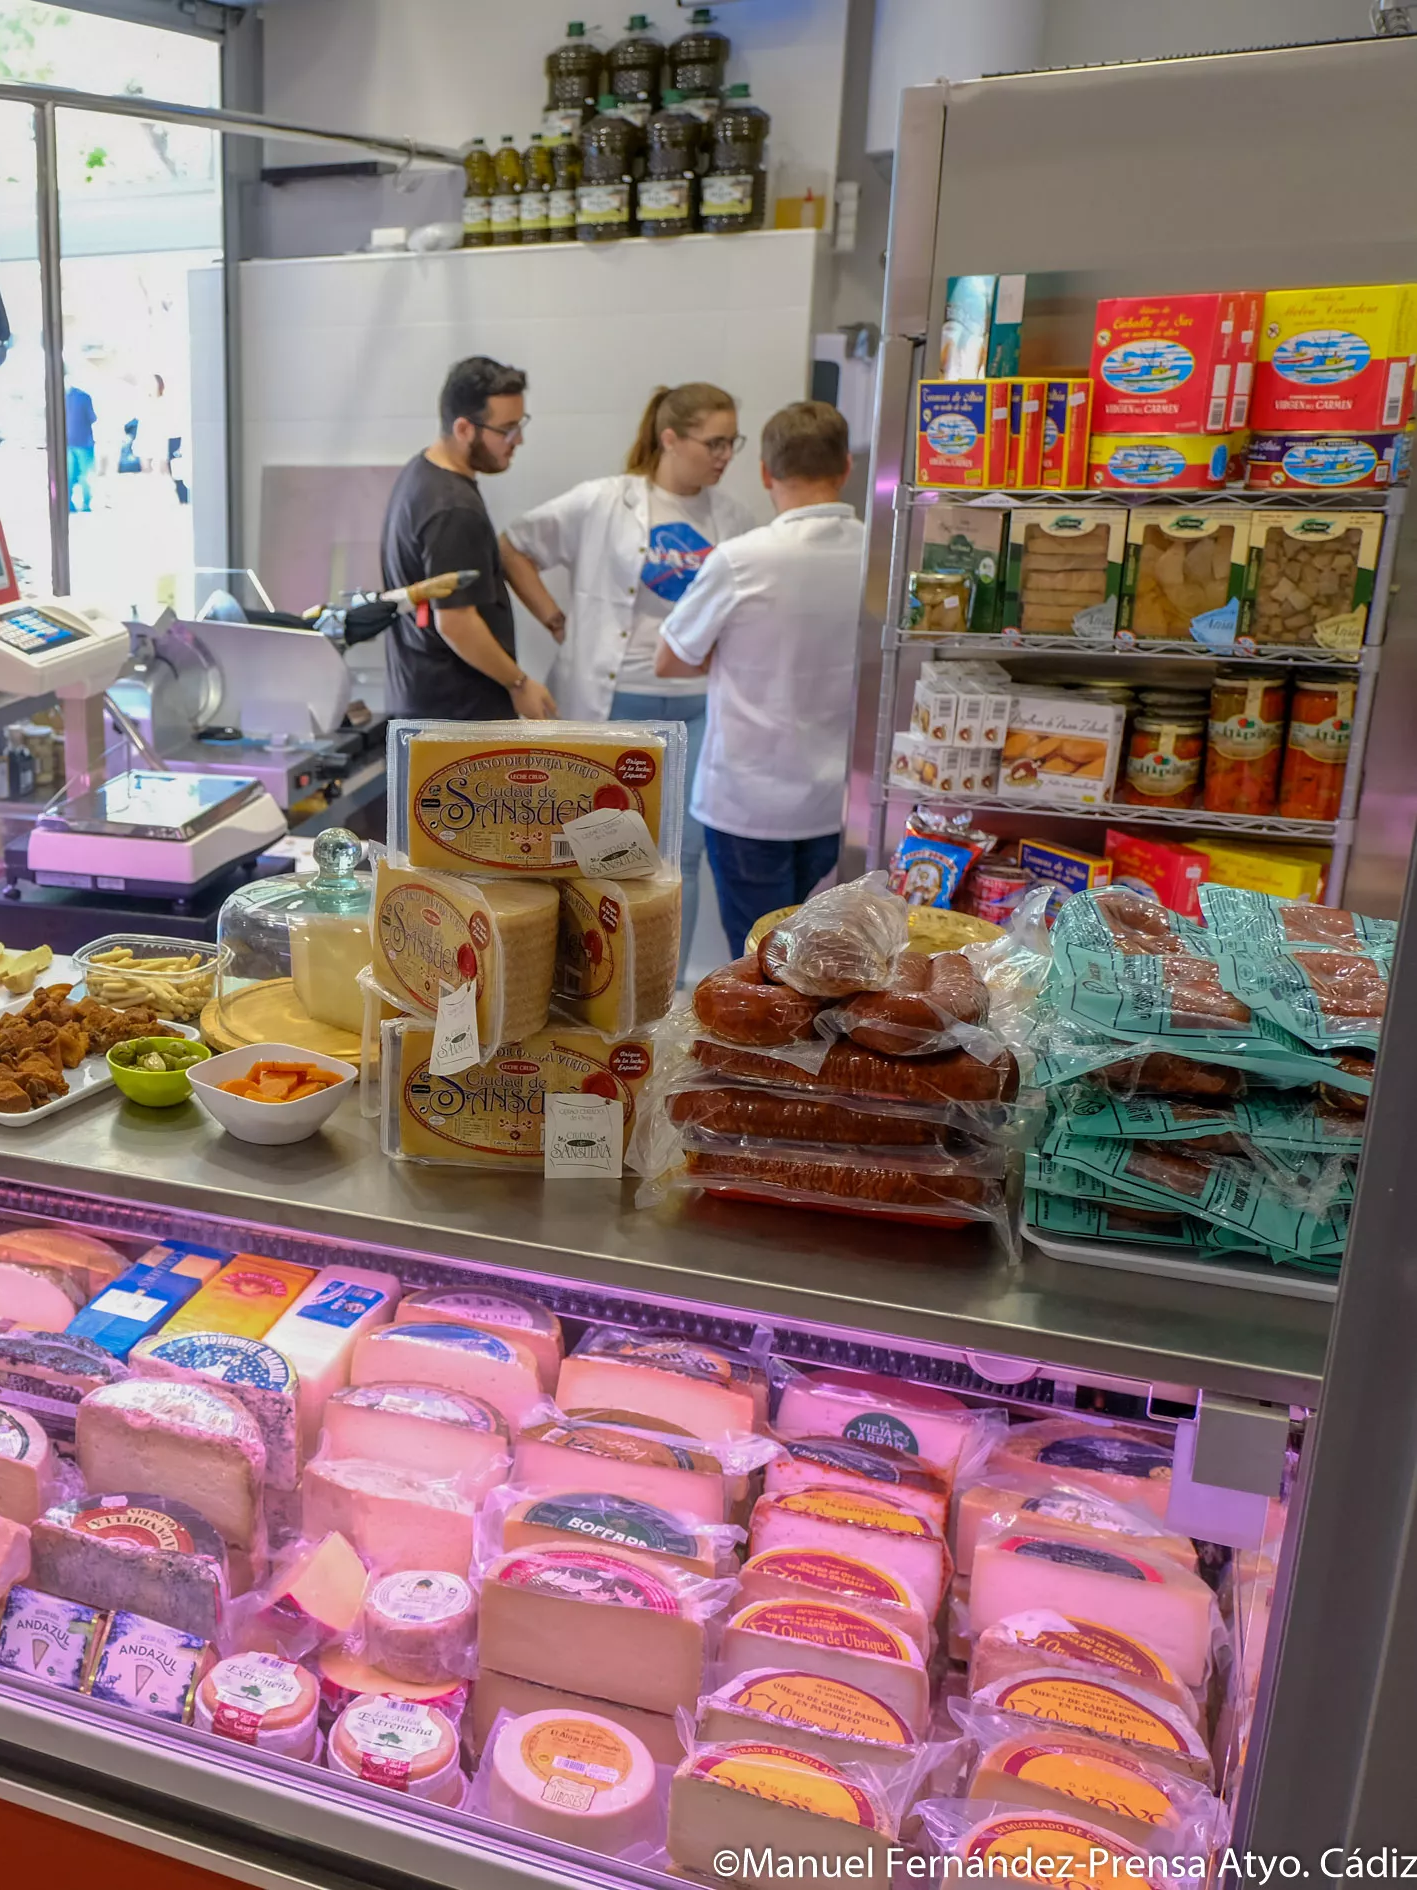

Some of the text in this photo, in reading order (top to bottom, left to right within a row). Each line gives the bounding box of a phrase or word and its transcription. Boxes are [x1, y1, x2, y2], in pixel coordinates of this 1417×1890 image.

[647, 546, 703, 570] NAS
[457, 756, 600, 780] QUESO DE OVEJA VIEJO
[509, 773, 548, 781] LECHE CRUDA
[475, 781, 558, 798] Ciudad de
[440, 778, 593, 831] SANSUEÑ
[466, 1070, 547, 1088] Ciudad de
[500, 1064, 518, 1072] LECHE
[566, 1131, 597, 1139] CIUDAD
[859, 1422, 892, 1439] VIEJA
[880, 1420, 890, 1428] LA
[17, 1619, 71, 1649] ANDAZUL
[781, 1626, 891, 1653] Quesos de Ubrique
[119, 1644, 177, 1675] ANDAZUL
[226, 1664, 295, 1693] Extremeña
[815, 1683, 861, 1701] MADURADO
[1030, 1688, 1066, 1702] QUESO
[1067, 1697, 1081, 1706] DE
[1083, 1702, 1117, 1717] CABRA
[773, 1682, 891, 1728] QUESO DE CABRA PAYOYA
[795, 1699, 861, 1725] EN PASTOREO
[1073, 1704, 1128, 1725] PASTOREO
[358, 1711, 434, 1737] Extremeña
[732, 1747, 821, 1769] URADO DE OVEJA
[758, 1780, 813, 1802] QUESO
[1068, 1782, 1127, 1800] QUESO
[994, 1821, 1083, 1836] SEMICURADO DE
